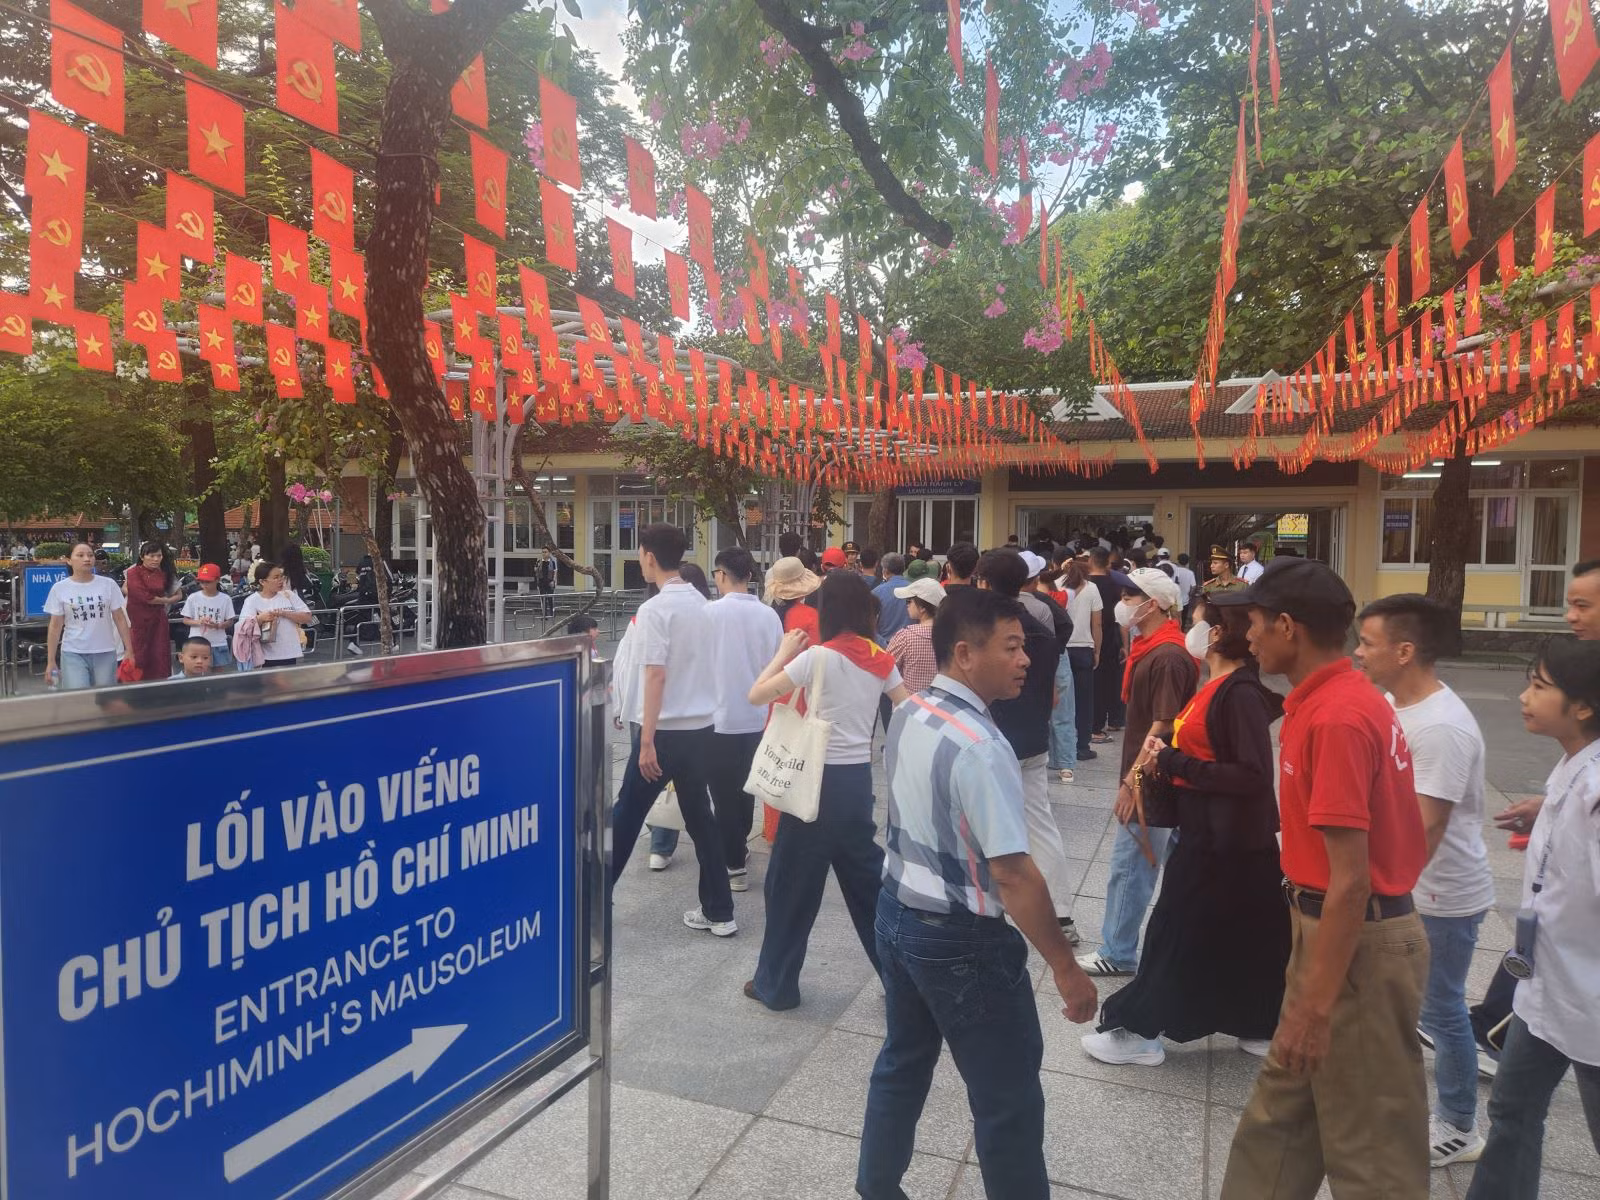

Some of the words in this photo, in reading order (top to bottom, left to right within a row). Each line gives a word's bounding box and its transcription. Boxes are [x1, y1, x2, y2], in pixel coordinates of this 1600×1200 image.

[32, 571, 53, 584] NHÀ
[186, 791, 265, 881] LỐI
[282, 780, 365, 851] VÀO
[378, 747, 480, 822] VIẾNG
[784, 758, 805, 771] ild
[58, 906, 181, 1022] CHỦ
[200, 880, 310, 970] TỊCH
[325, 841, 379, 922] HỒ
[392, 823, 449, 895] CHÍ
[461, 803, 539, 870] MINH
[215, 925, 409, 1044] ENTRANCE
[415, 906, 455, 952] TO
[68, 1000, 362, 1178] HOCHIMINH'S
[371, 911, 541, 1021] MAUSOLEUM
